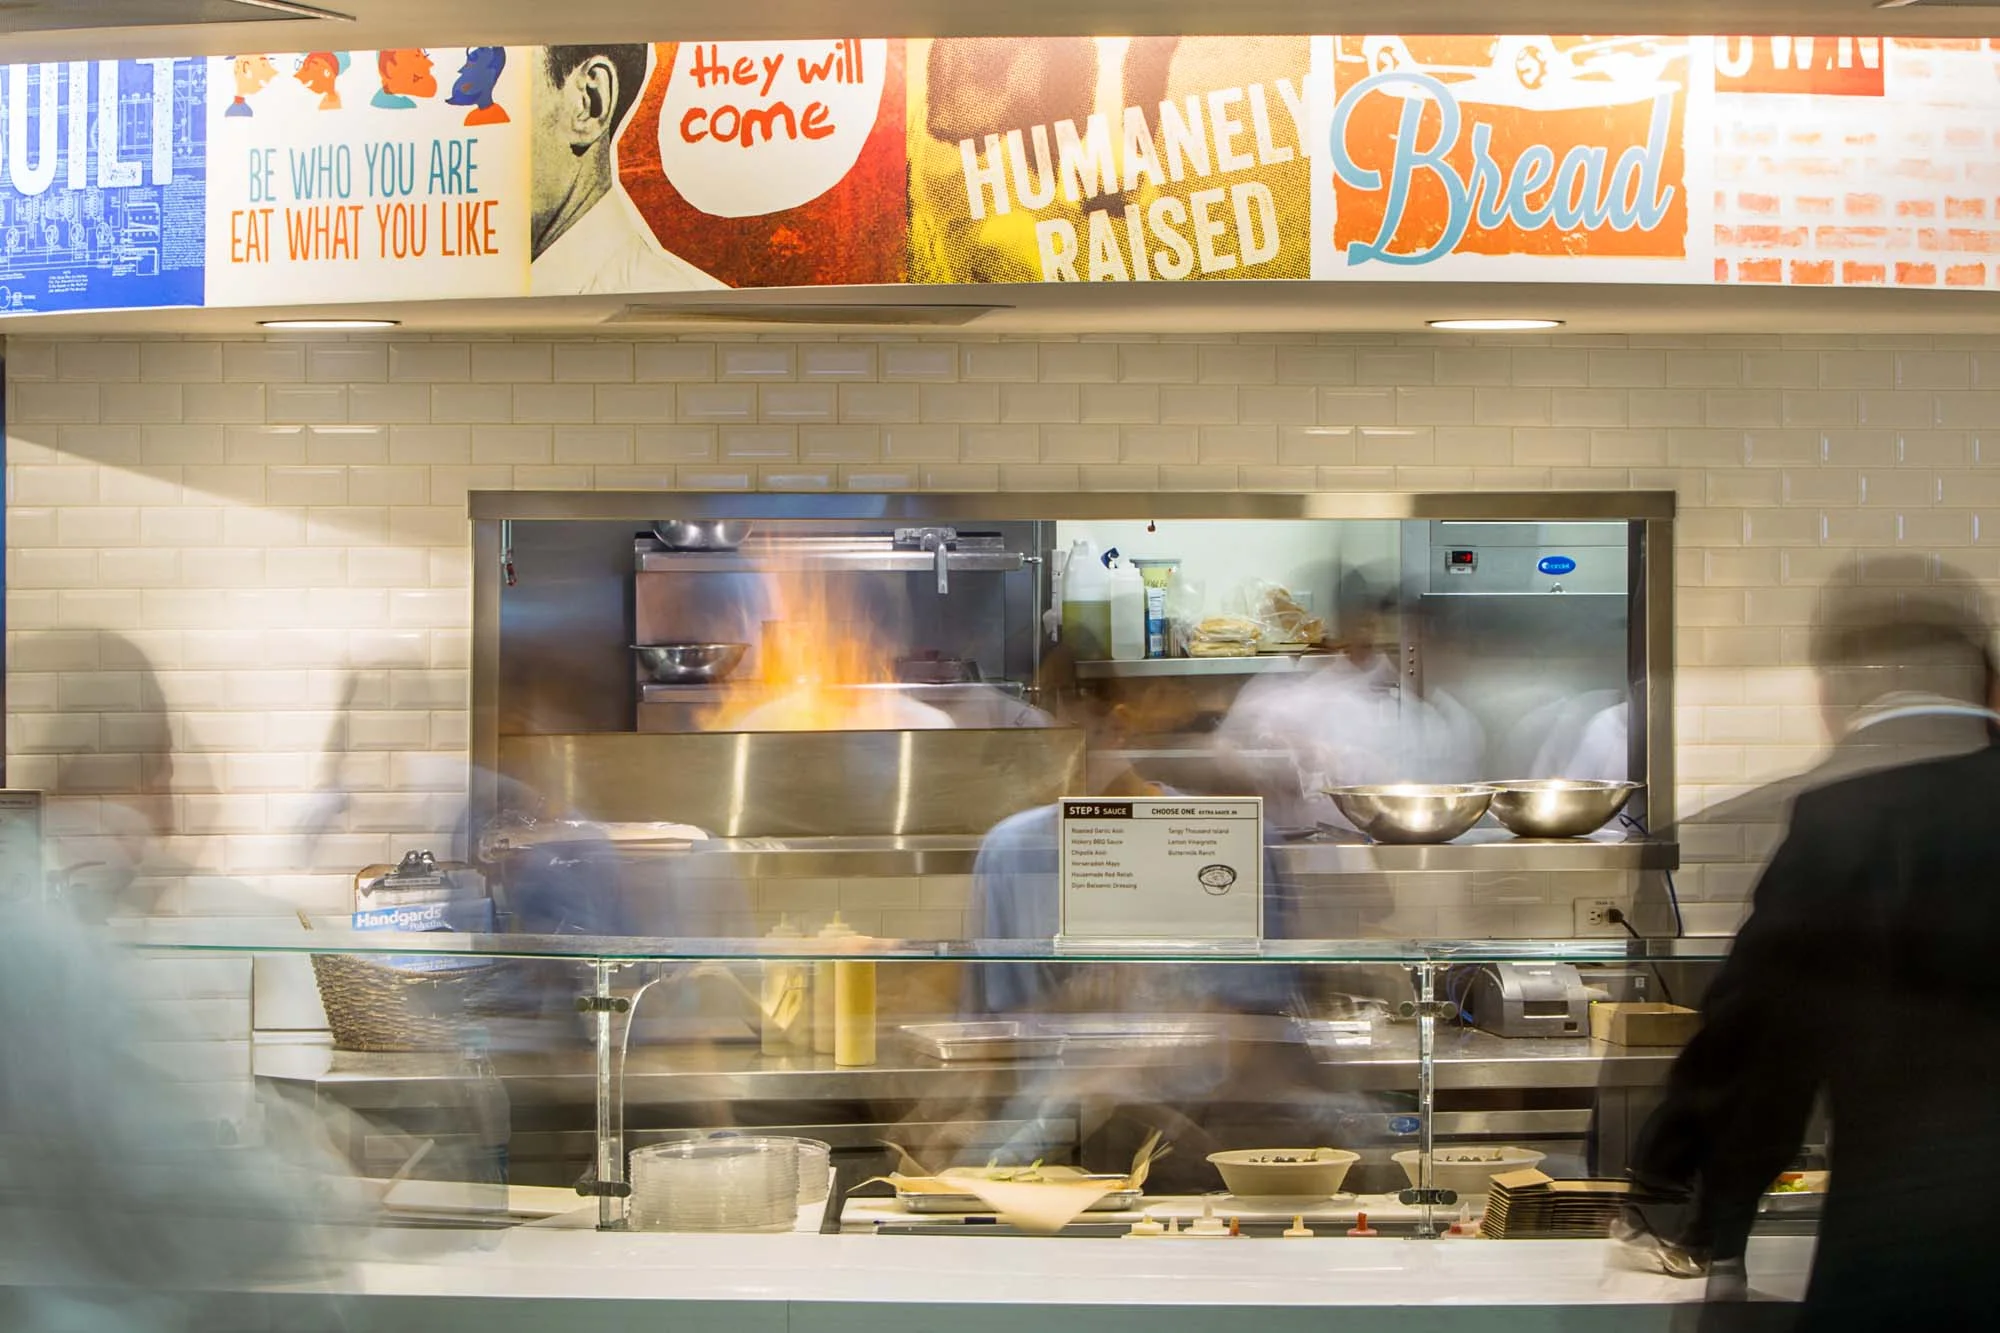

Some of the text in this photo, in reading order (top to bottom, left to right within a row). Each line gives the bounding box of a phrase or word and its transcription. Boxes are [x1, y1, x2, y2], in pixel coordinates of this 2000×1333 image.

[690, 38, 864, 97] they will
[679, 101, 836, 148] come
[959, 74, 1311, 220] HUMANELY
[249, 138, 479, 203] BE WHO YOU ARE
[1329, 72, 1676, 266] Bread
[231, 208, 275, 263] EAT
[285, 204, 364, 261] WHAT
[376, 203, 427, 259] YOU
[441, 200, 499, 256] LIKE
[1035, 181, 1281, 282] RAISED
[1069, 806, 1093, 815] STEP
[1094, 806, 1100, 815] 5
[356, 904, 442, 928] Handgards
